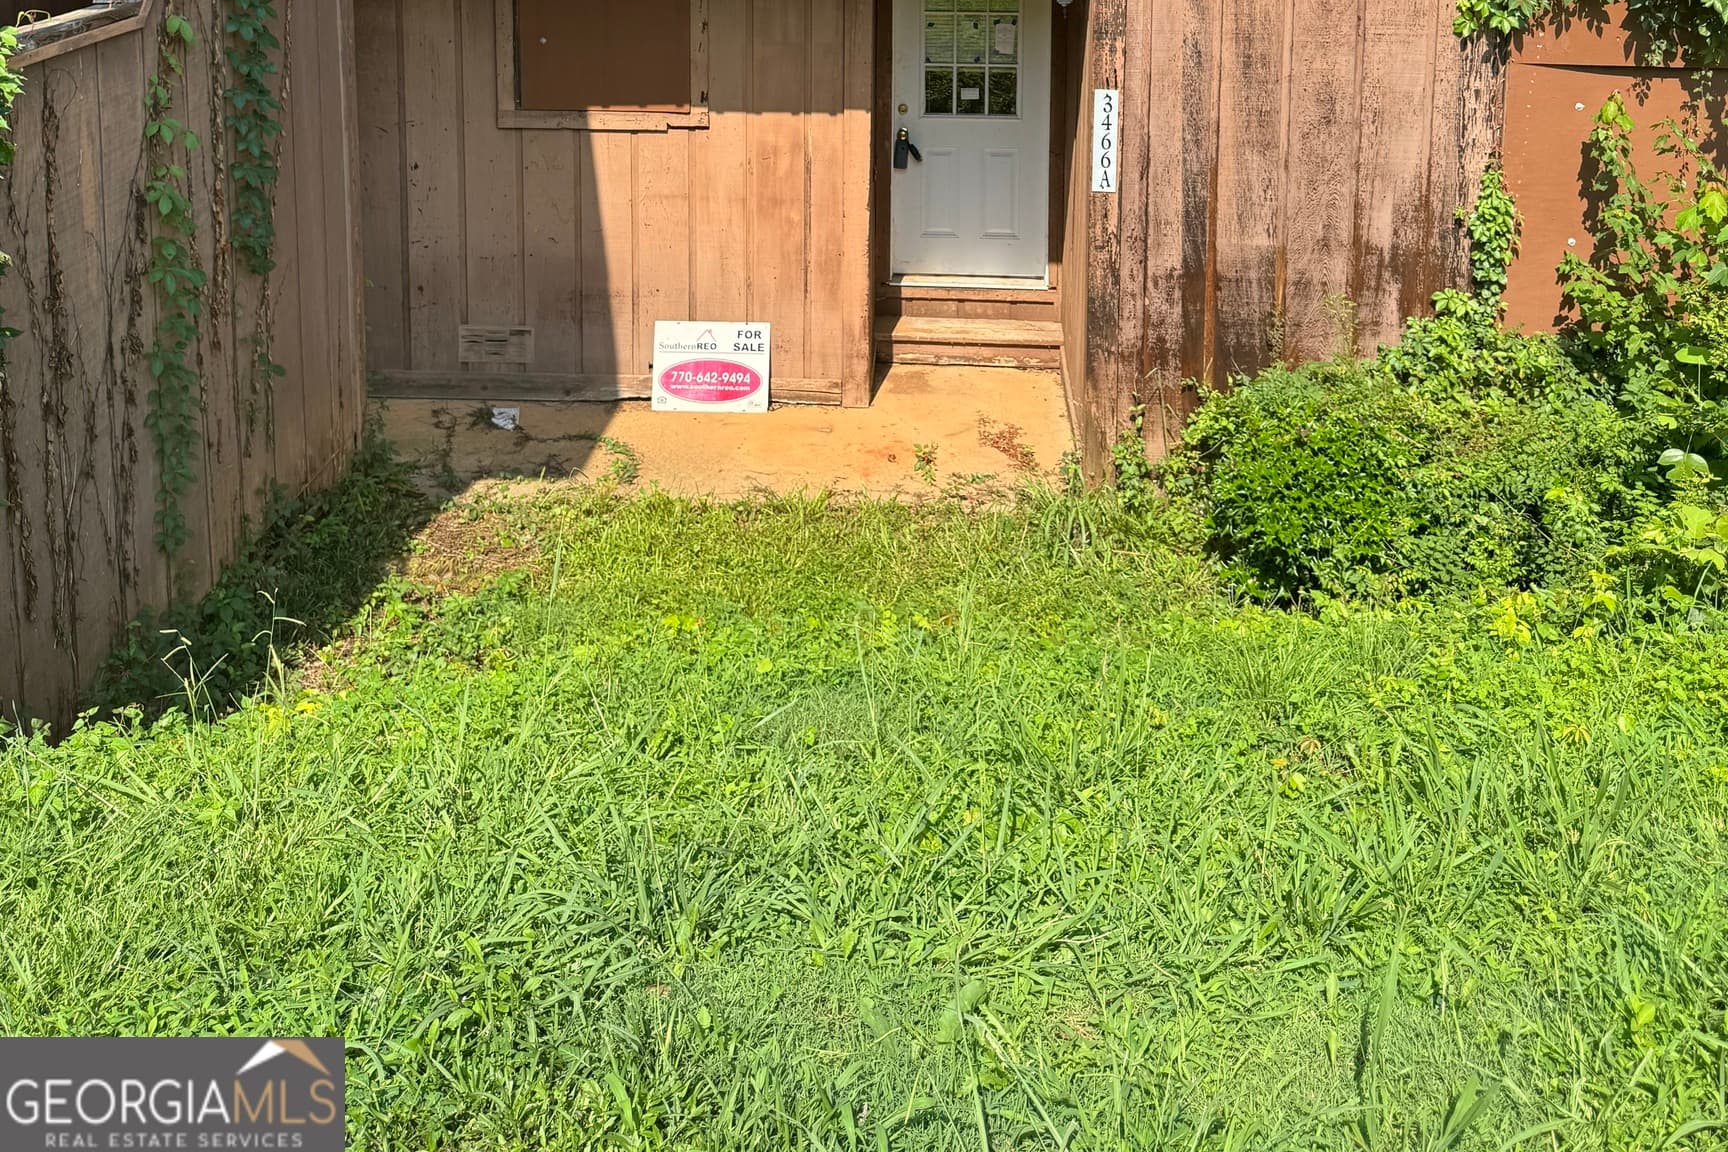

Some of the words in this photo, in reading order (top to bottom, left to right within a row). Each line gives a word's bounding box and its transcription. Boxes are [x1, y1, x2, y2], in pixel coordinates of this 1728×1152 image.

[1099, 94, 1113, 188] 3466A
[737, 330, 762, 340] FOR
[733, 343, 765, 352] SALE
[671, 371, 751, 384] 770-642-9494
